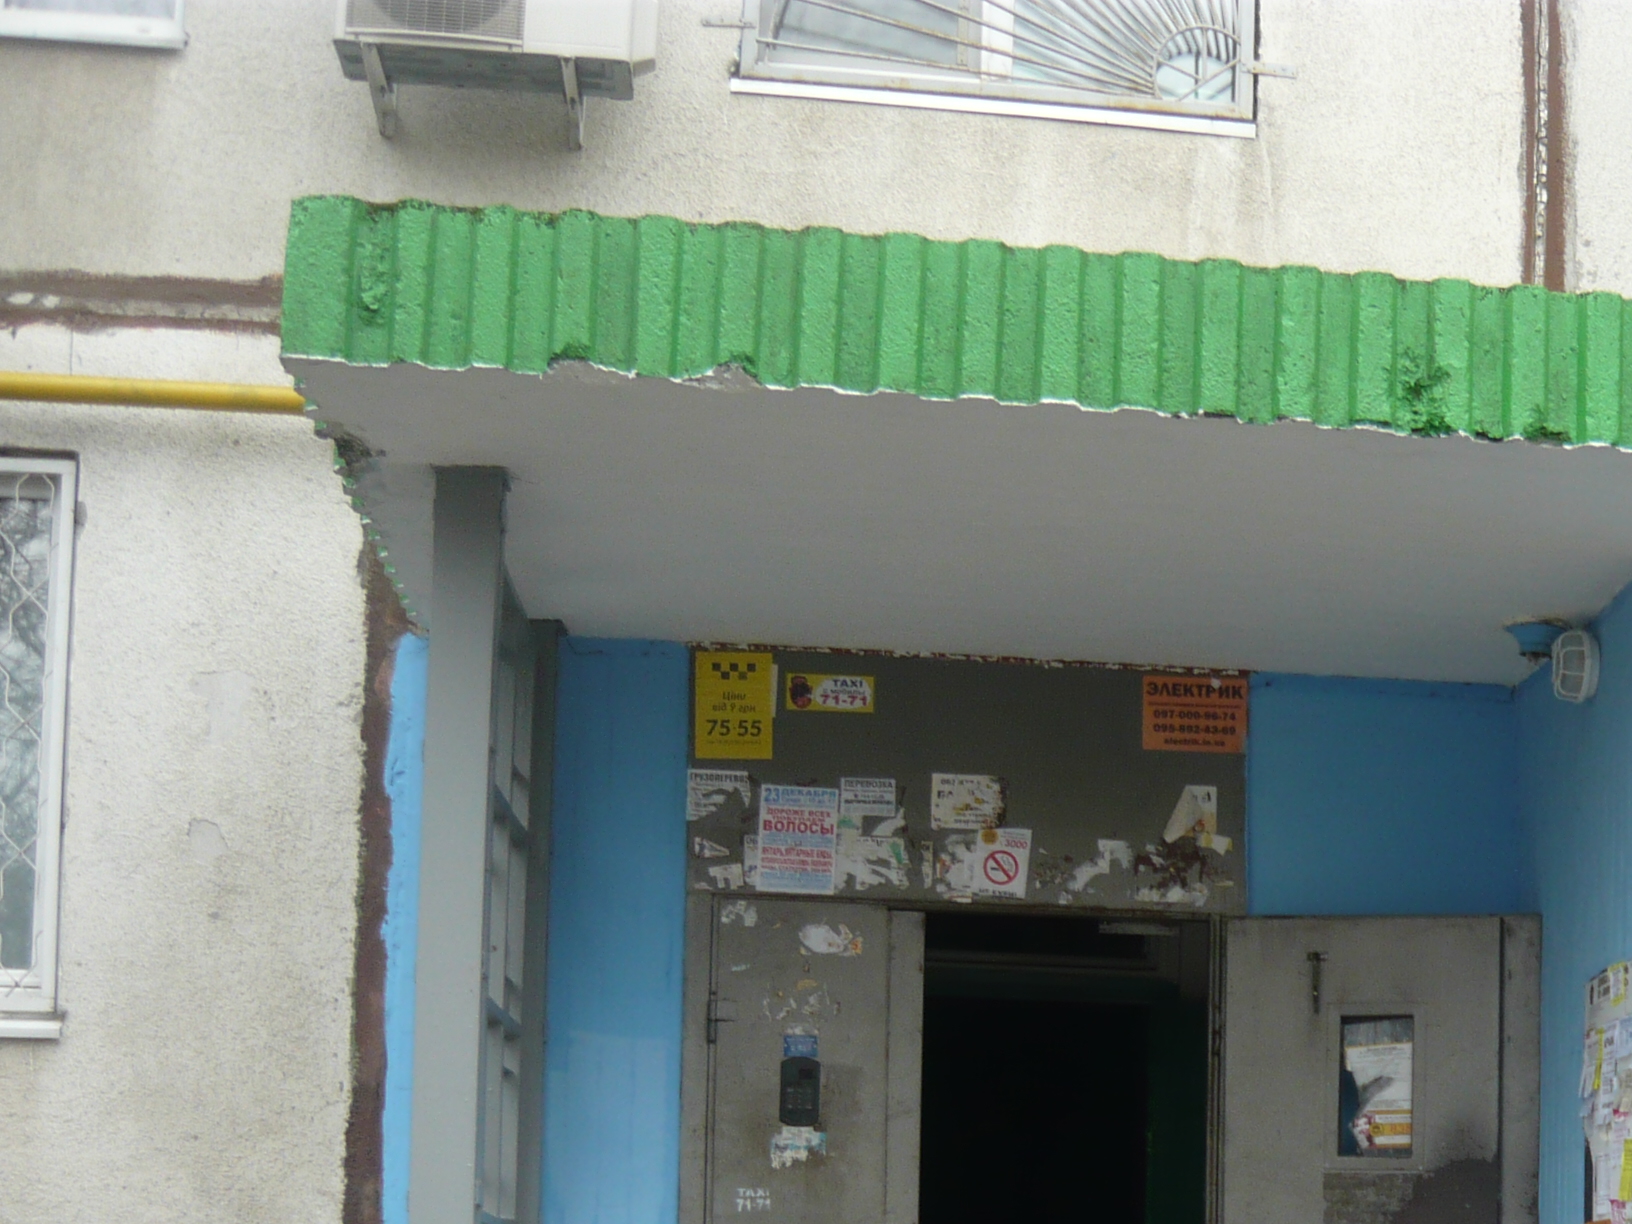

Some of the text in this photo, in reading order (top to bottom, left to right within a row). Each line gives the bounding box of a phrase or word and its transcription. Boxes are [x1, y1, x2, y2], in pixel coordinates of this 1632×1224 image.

[832, 679, 863, 688] TAXI
[722, 690, 746, 702] Ціни
[1147, 682, 1244, 699] ЭЛЕКТРИК
[820, 694, 868, 706] 71-71
[844, 779, 893, 789] ПЕРЕВОЗКА
[764, 787, 780, 802] 23
[781, 788, 836, 798] ДЕКАБРЯ
[767, 807, 831, 818] ДОРОЖЕ ВСЕХ
[763, 819, 834, 835] ВОЛОСЫ
[1005, 839, 1028, 850] 3000
[737, 1188, 769, 1197] TAXI
[736, 1198, 771, 1212] 71-71
